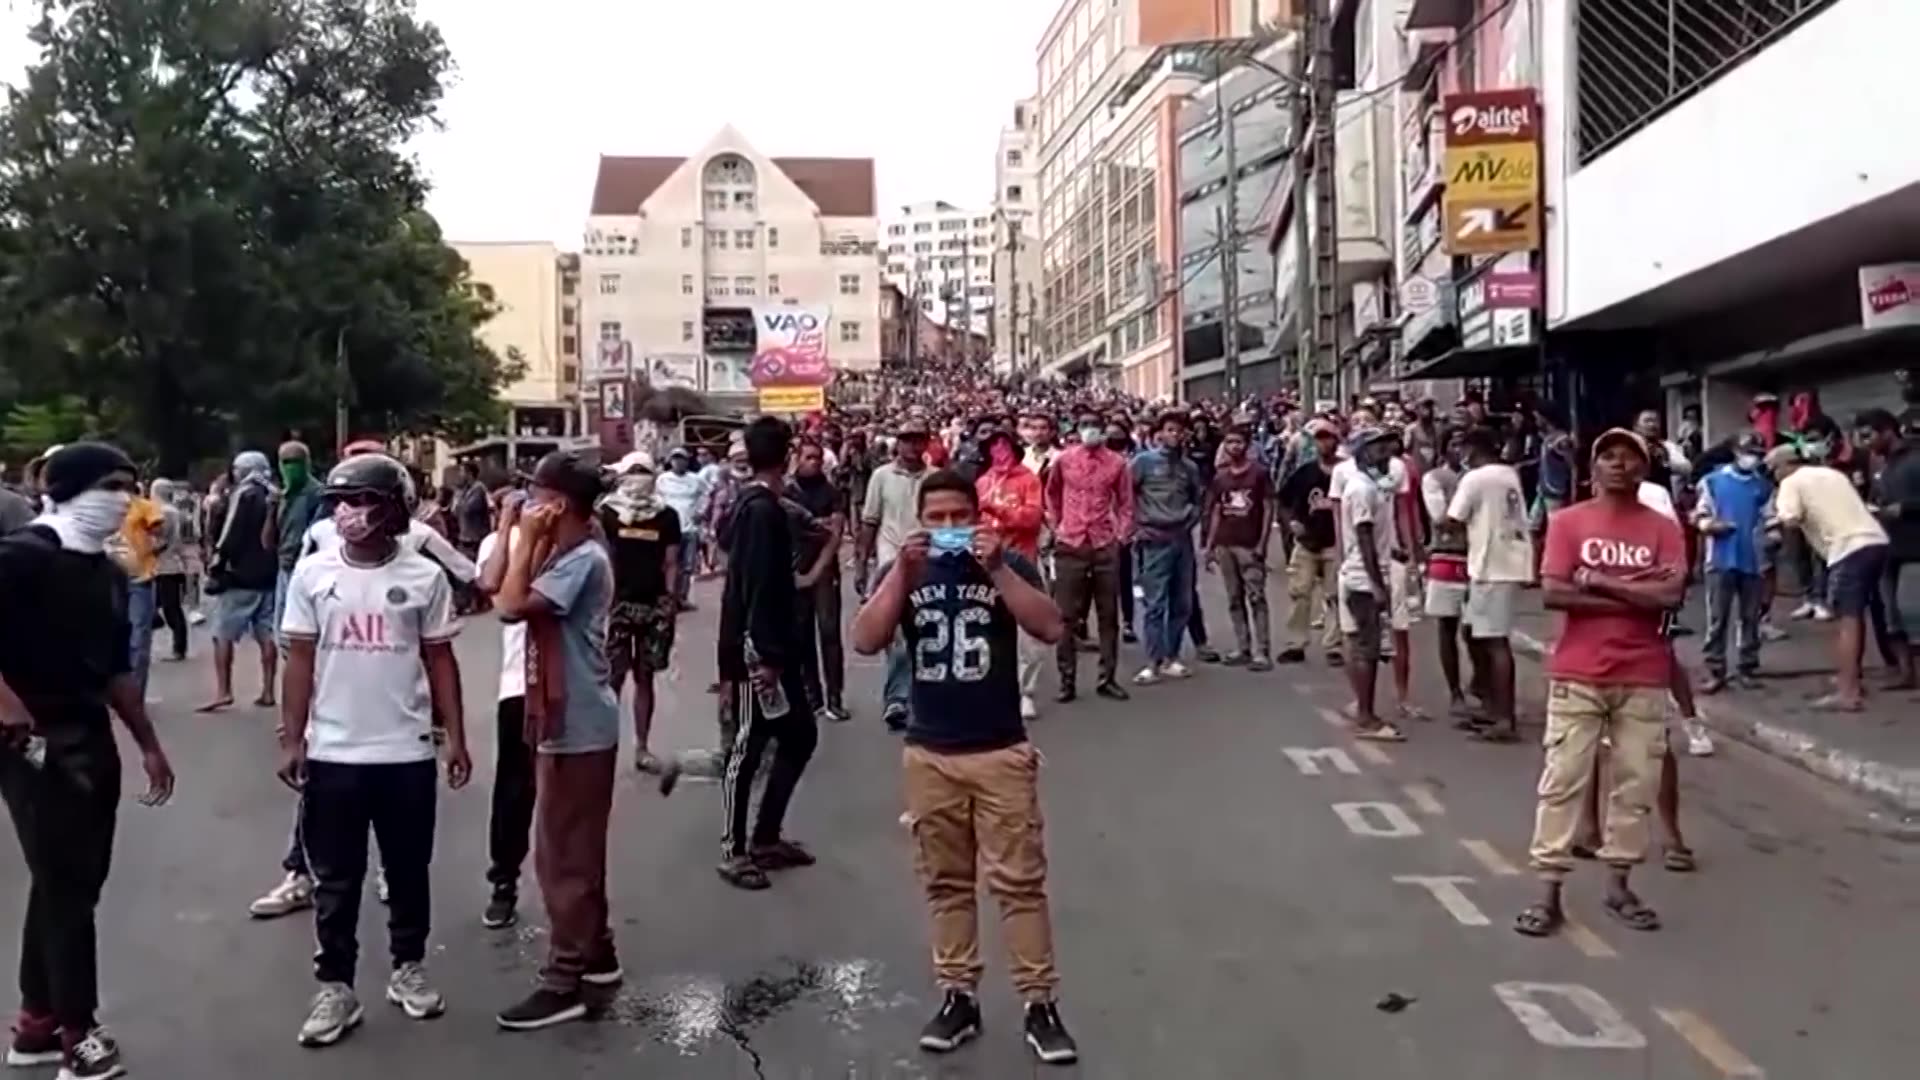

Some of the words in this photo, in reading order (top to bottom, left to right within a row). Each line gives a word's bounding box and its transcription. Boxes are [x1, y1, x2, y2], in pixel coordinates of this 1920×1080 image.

[1477, 105, 1530, 129] airtel
[764, 313, 818, 332] VAO
[1580, 536, 1653, 567] Coke
[908, 583, 947, 608] NEW
[956, 583, 1000, 607] YORK
[913, 606, 992, 682] 26
